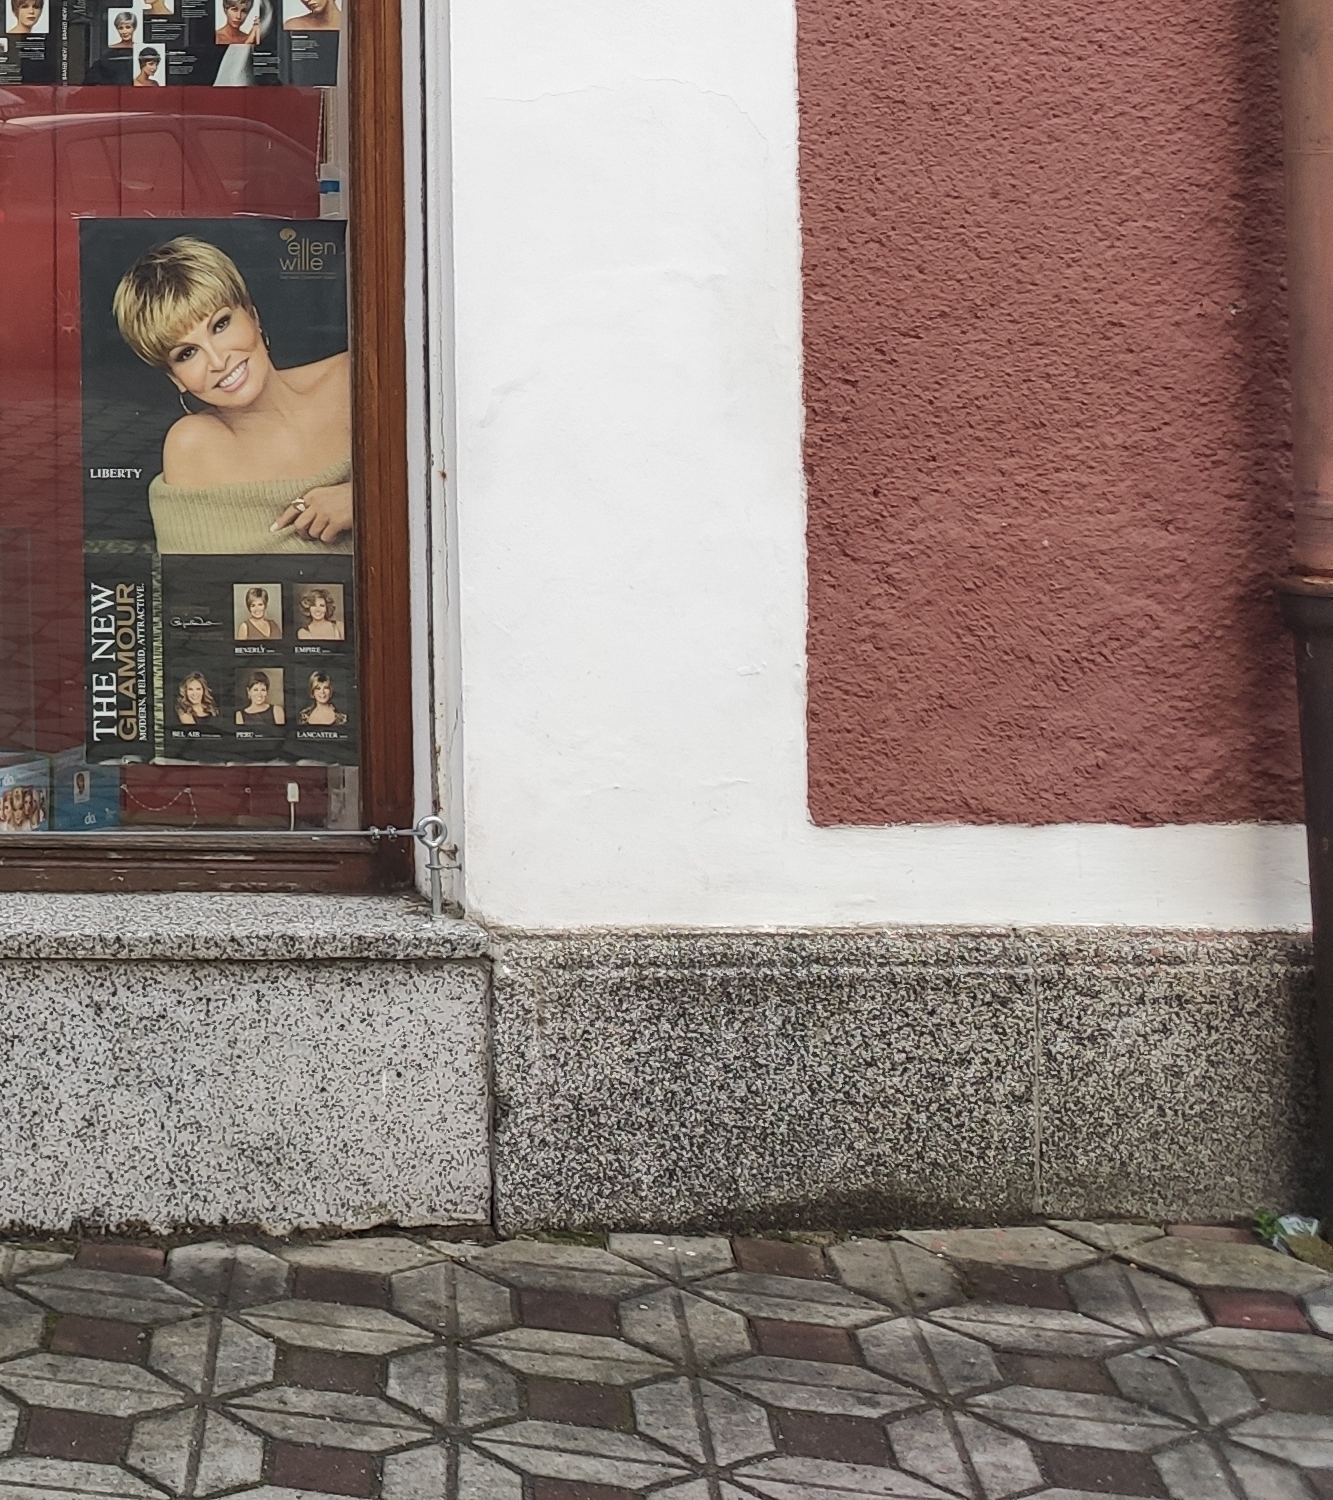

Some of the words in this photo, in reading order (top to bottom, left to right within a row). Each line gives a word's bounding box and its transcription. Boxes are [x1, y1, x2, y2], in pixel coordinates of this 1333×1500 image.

[279, 254, 324, 271] wille
[287, 237, 337, 255] ellen
[89, 468, 143, 479] LIBERTY
[90, 582, 117, 662] NEW
[116, 583, 138, 741] GLAMOUR
[92, 672, 118, 742] THE
